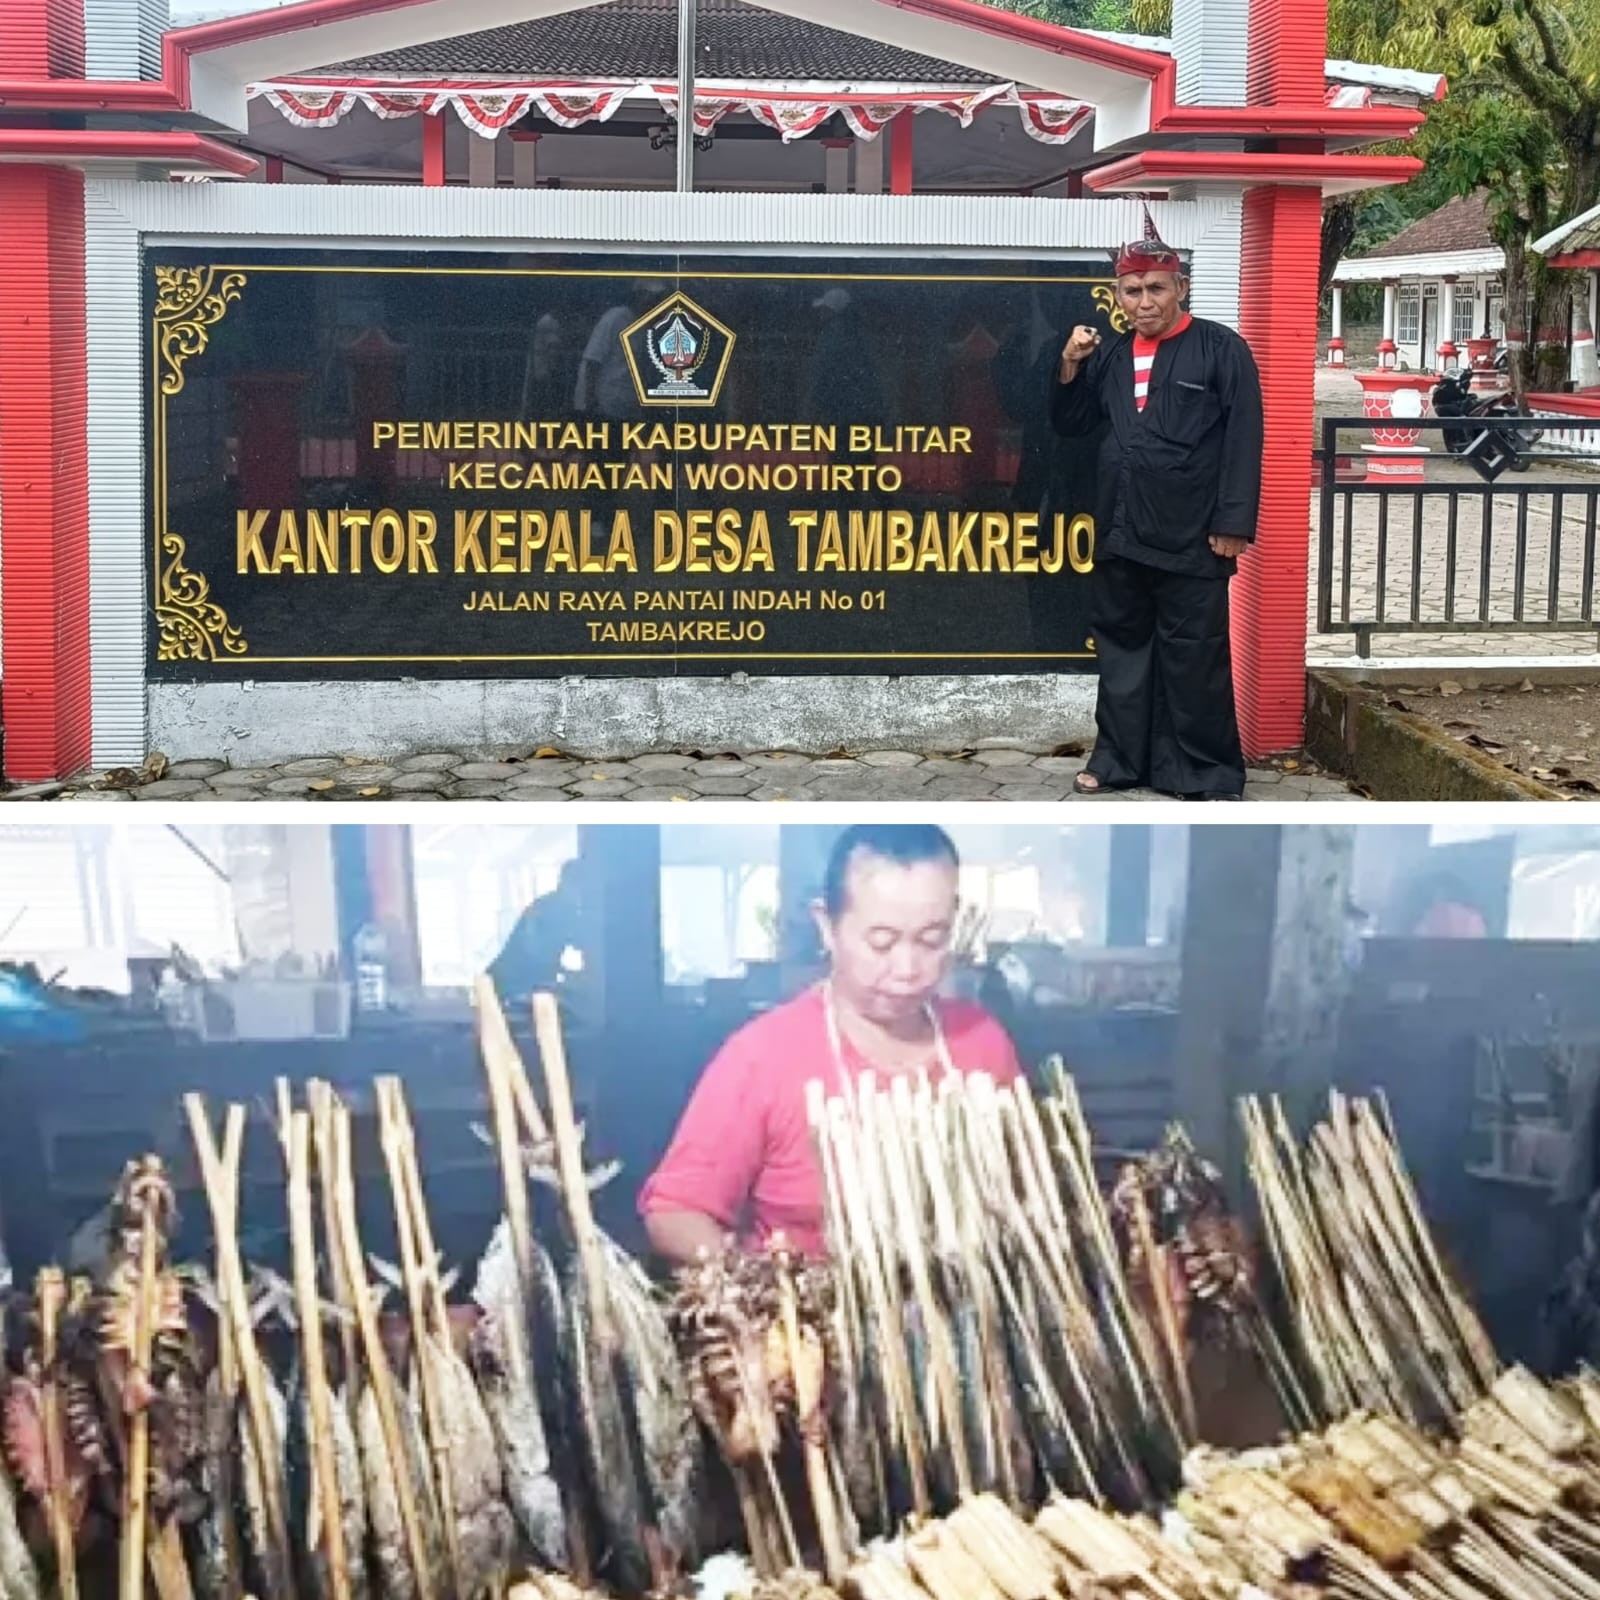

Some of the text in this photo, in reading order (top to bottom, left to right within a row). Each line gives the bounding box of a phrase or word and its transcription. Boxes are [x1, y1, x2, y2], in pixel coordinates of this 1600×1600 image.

[373, 421, 973, 454] PEMERINTAH KABUPATEN BLITAR
[448, 461, 903, 492] KECAMATAN WONOTIRTO
[236, 507, 1095, 575] KANTOR KEPALA DESA TAMBAKREJO
[463, 590, 886, 611] JALAN RAYA PANTAI INDAH No 01
[587, 620, 766, 642] TAMBAKREJO
